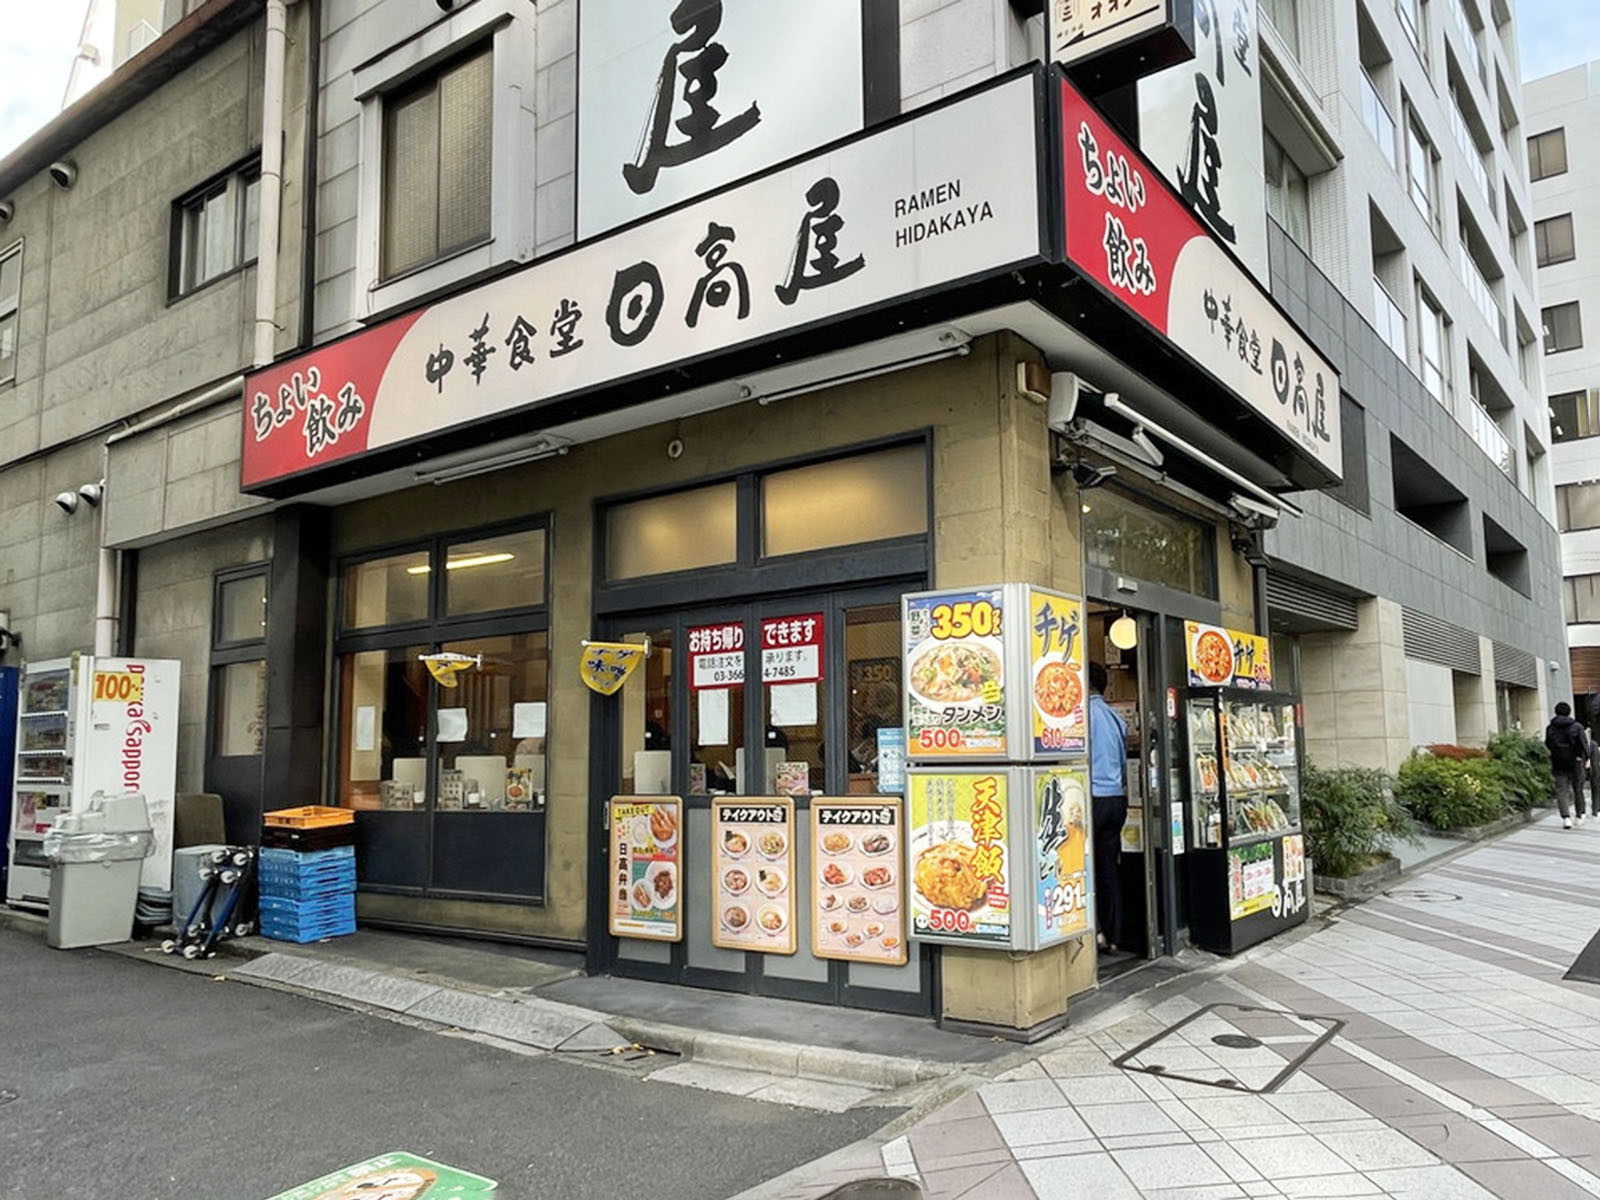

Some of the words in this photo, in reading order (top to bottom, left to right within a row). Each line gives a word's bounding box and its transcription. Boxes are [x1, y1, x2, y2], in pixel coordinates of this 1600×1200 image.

[894, 178, 961, 218] RAMEN
[1077, 121, 1146, 213] ちょい
[895, 200, 994, 248] HIDAKAYA
[1103, 211, 1156, 296] 飲み
[426, 298, 583, 394] 中華食堂
[606, 177, 866, 346] 日高屋
[251, 366, 321, 441] ちょい
[302, 382, 365, 458] 飲み
[690, 626, 744, 652] お持ち帰り
[763, 618, 816, 645] できます
[1035, 602, 1080, 665] チゲ
[943, 705, 1001, 723] タンメン
[722, 808, 772, 821] テイクアウト
[822, 810, 879, 824] テイクアウト
[970, 776, 1005, 884] 天津飯
